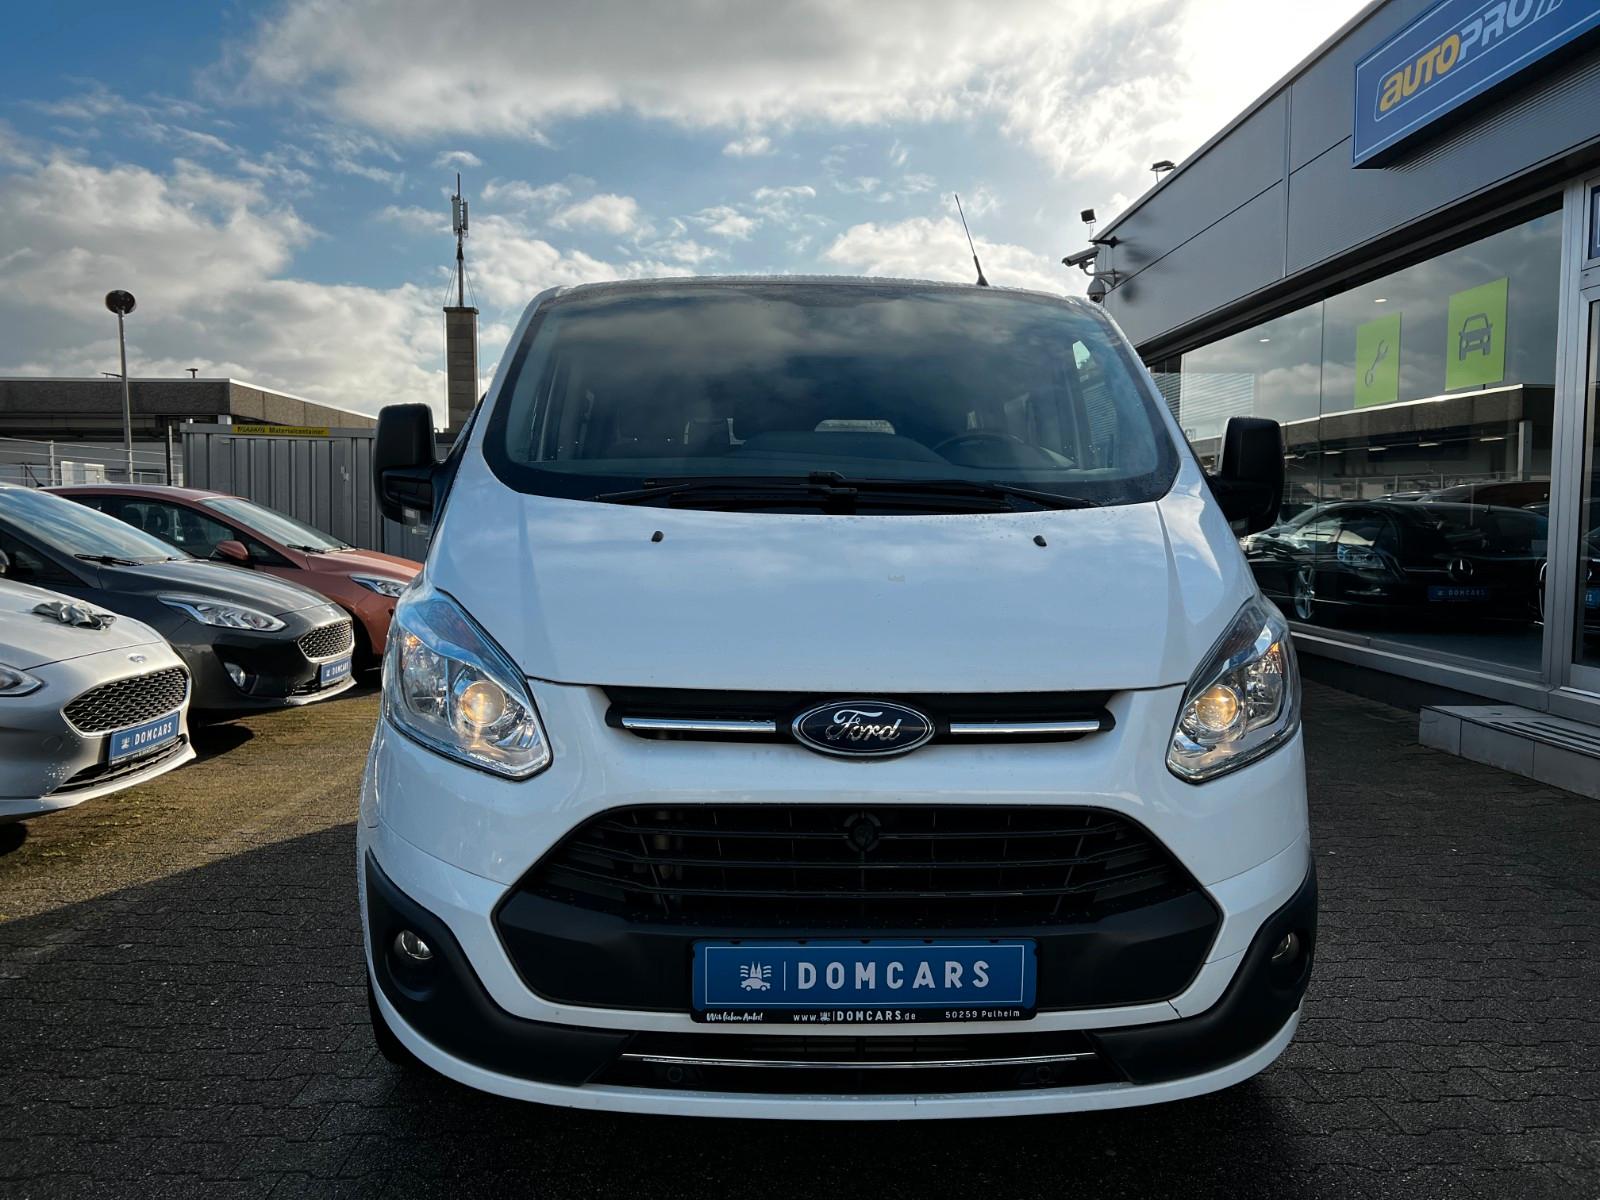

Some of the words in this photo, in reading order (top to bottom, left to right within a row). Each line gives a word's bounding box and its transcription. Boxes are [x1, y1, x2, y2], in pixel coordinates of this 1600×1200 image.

[134, 722, 172, 745] DOMCARS
[825, 709, 902, 741] Ford
[798, 961, 989, 990] DOMCARS
[945, 1010, 977, 1019] 50259
[981, 1010, 1020, 1018] Pulheim
